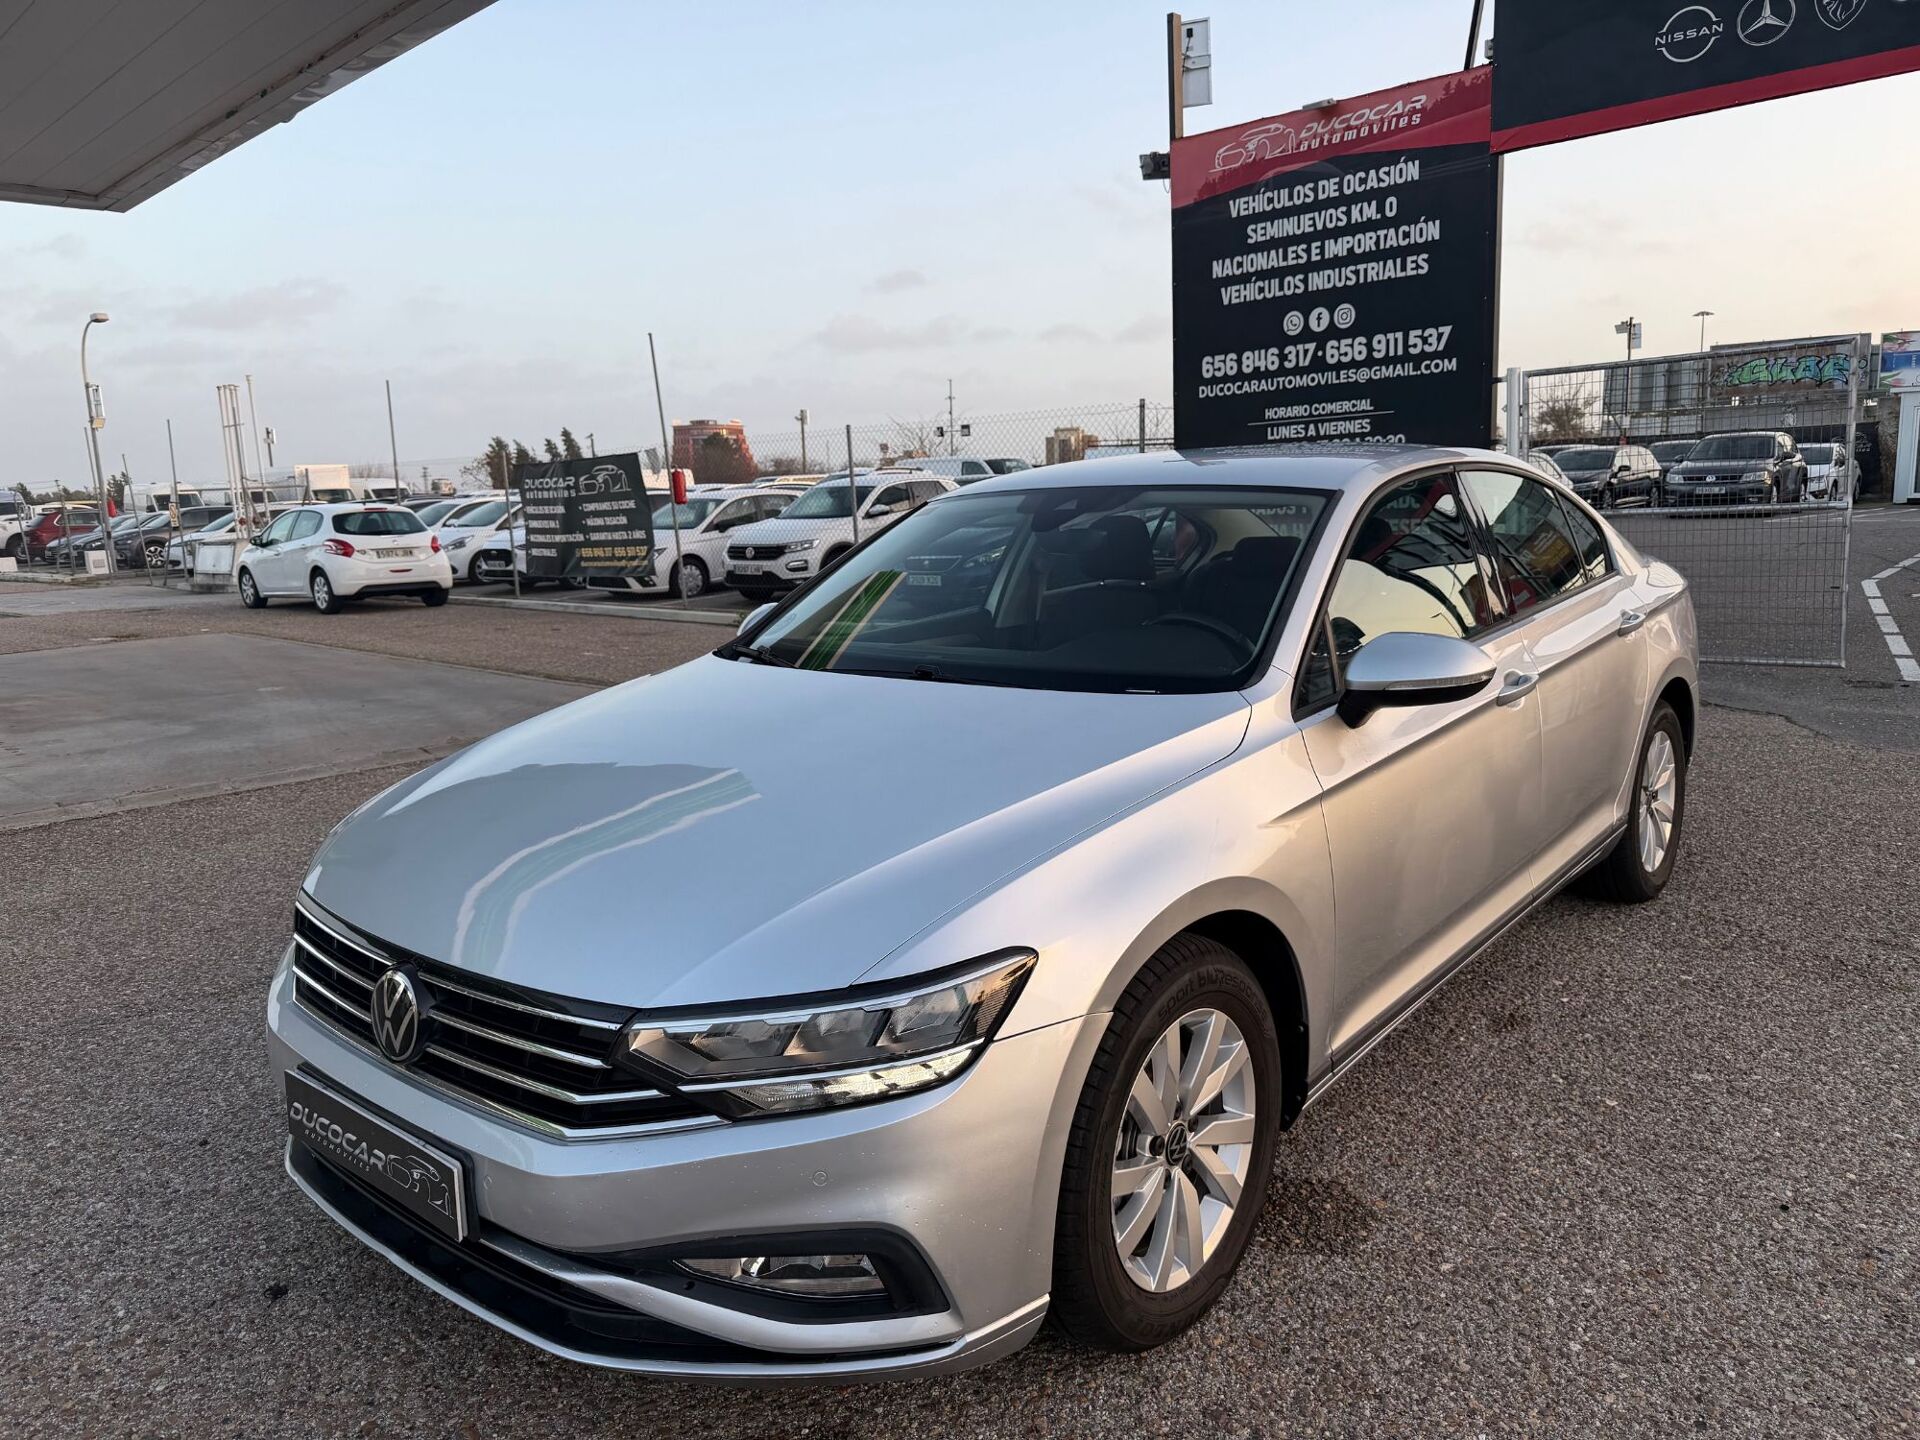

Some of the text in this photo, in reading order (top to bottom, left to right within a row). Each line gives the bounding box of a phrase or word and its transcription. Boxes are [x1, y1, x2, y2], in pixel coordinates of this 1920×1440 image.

[1654, 22, 1724, 47] NISSAN
[1299, 94, 1428, 139] DUCOCAR
[1229, 156, 1420, 218] VEHÍCULOS DE OCASIÓN
[1246, 206, 1348, 244] SEMINUEVOS
[1350, 200, 1381, 225] KM.
[1212, 216, 1441, 279] NACIONALES E IMPORTACIÓN
[1220, 253, 1430, 306] VEHÍCULOS INDUSTRIALES
[1201, 353, 1238, 379] 656
[1241, 347, 1280, 374] 846
[1371, 332, 1403, 359] 911
[1407, 325, 1453, 354] 537
[1198, 357, 1457, 398] DUCOCARAUTOMOVILES@GMAIL.COM
[1264, 398, 1374, 420] HORARIO COMERCIAL
[1266, 423, 1306, 441] LUNES
[1307, 422, 1316, 437] A
[1317, 418, 1371, 436] VIERNES
[524, 476, 575, 490] DUCOCAR
[289, 1101, 387, 1173] DUCOCAR
